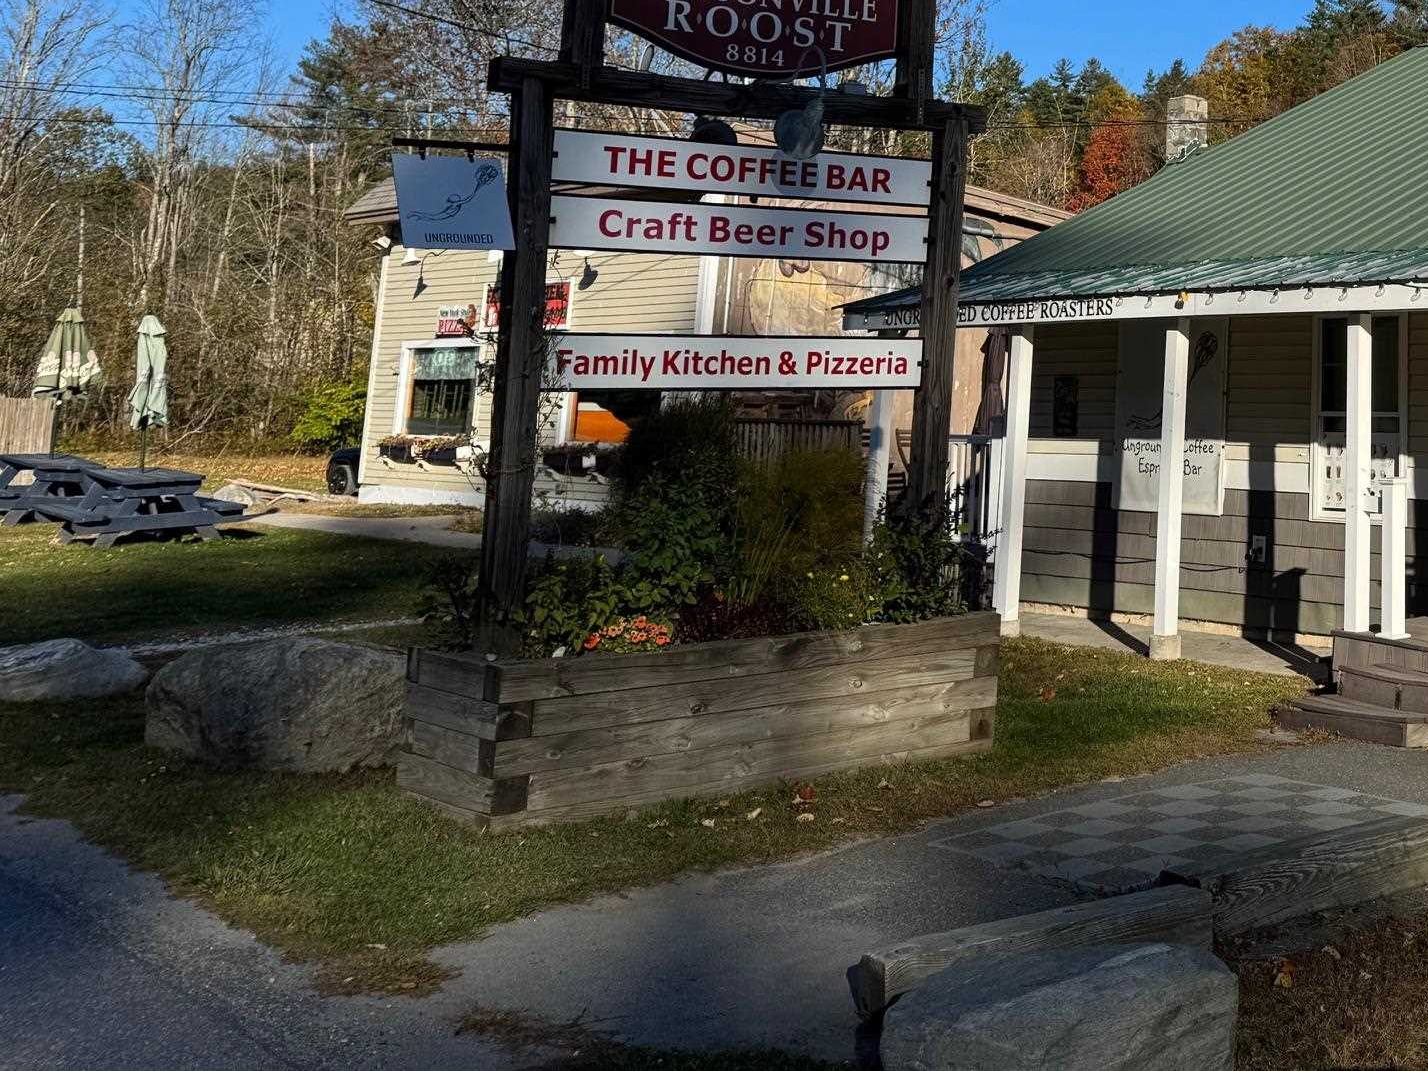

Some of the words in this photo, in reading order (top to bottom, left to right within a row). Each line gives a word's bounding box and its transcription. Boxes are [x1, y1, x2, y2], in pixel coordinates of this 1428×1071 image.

[726, 44, 784, 66] 8814
[604, 146, 677, 178] THE
[686, 153, 818, 188] COFFEE
[826, 164, 892, 194] BAR
[424, 232, 494, 244] UNGROUNDED
[598, 209, 697, 242] Craft
[708, 216, 794, 246] Beer
[804, 221, 890, 257] Shop
[885, 308, 977, 327] UNGRED
[981, 303, 1035, 322] COFFEE
[1040, 298, 1113, 319] ROASTERS
[558, 349, 656, 382] Family
[661, 350, 771, 376] Kitchen
[777, 350, 798, 376] &
[806, 350, 908, 376] Pizzeria
[1121, 437, 1161, 455] Ungroun
[1138, 457, 1160, 477] Espr
[1183, 459, 1202, 475] Bar
